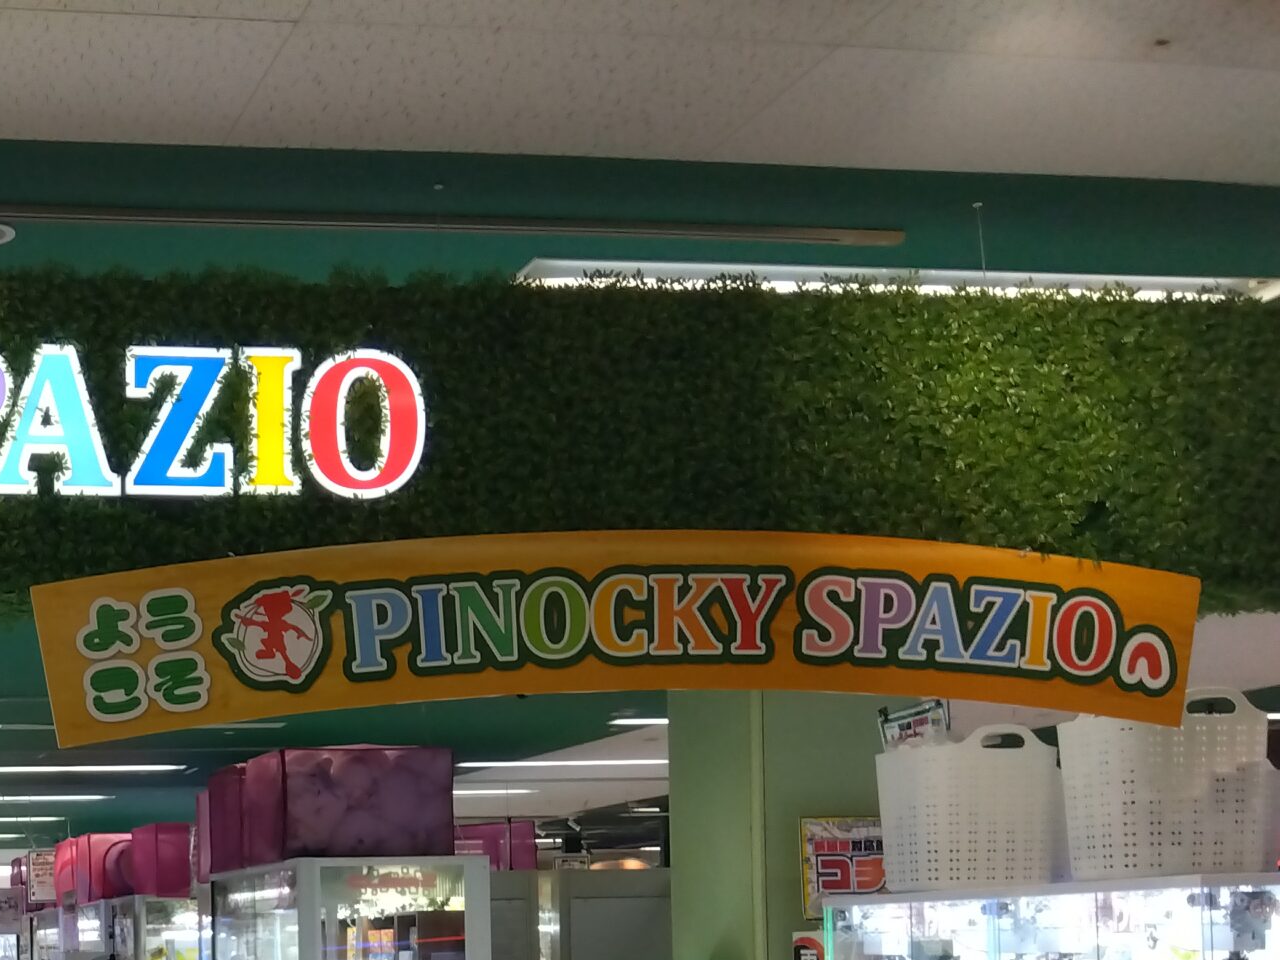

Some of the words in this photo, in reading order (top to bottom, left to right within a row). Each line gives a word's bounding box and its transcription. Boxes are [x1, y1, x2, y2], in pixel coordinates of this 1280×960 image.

[76, 588, 203, 660] よう
[345, 574, 786, 674] PINOCKY
[802, 576, 1117, 676] SPAZIO
[84, 650, 211, 722] こそ
